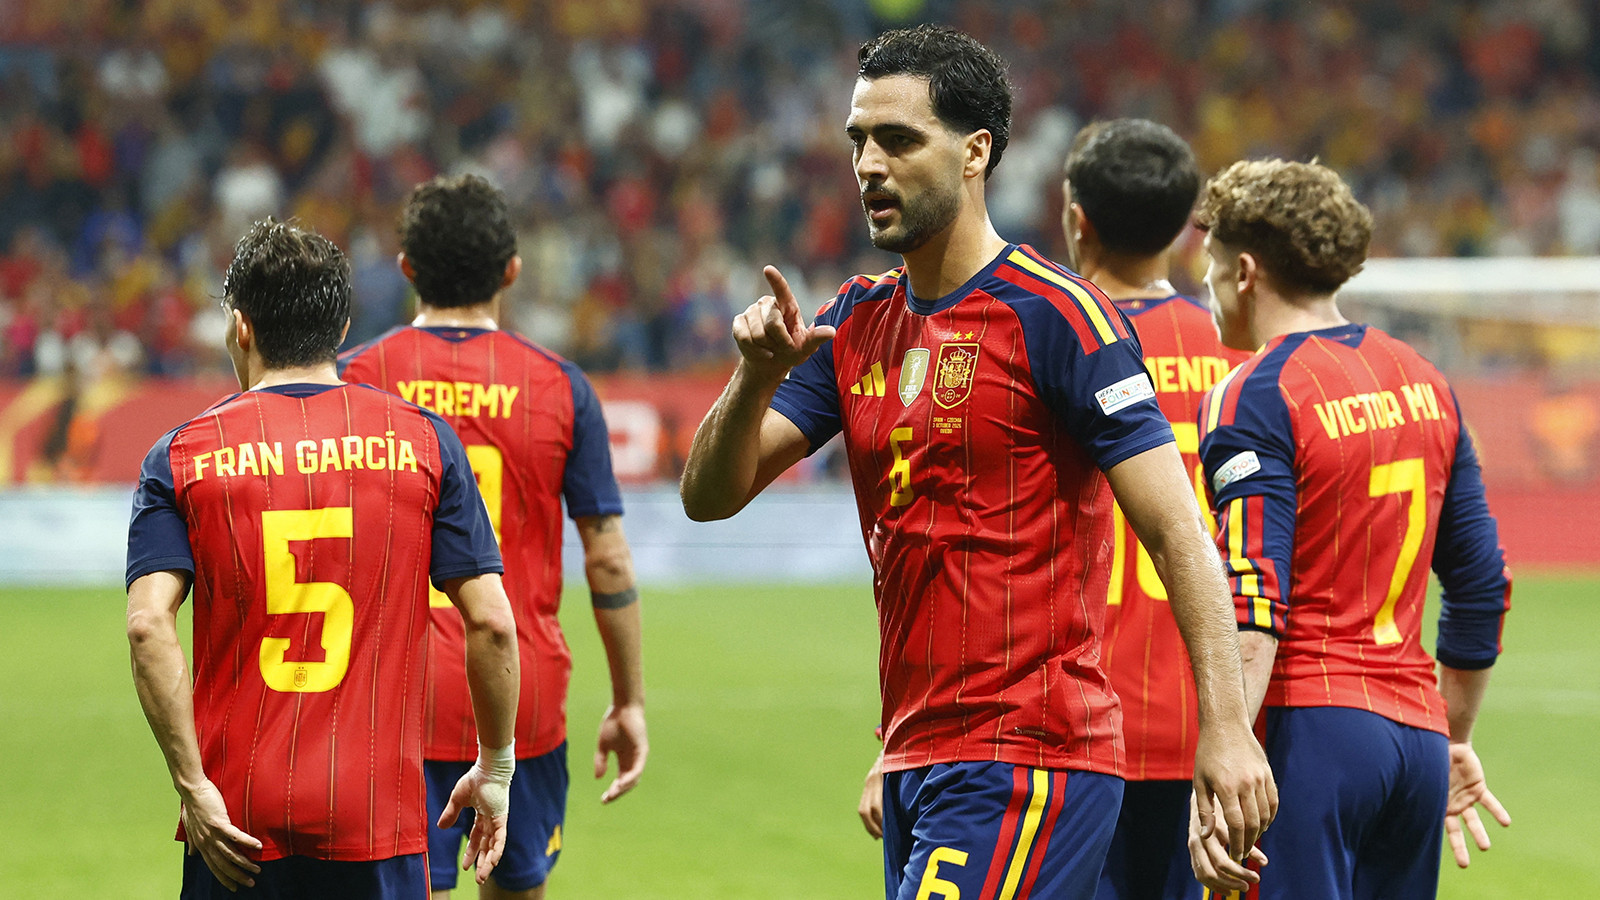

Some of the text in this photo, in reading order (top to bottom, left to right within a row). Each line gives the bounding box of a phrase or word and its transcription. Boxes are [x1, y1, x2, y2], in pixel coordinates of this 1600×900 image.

[397, 380, 519, 419] YEREMY
[1098, 388, 1114, 399] UEFA
[1101, 380, 1150, 407] FOUNDATIO
[1313, 390, 1406, 440] VICTOR
[193, 430, 418, 480] FRAN GARCÍA
[889, 426, 914, 507] 6
[1369, 458, 1426, 646] 7
[259, 507, 354, 693] 5
[914, 846, 969, 900] 6
